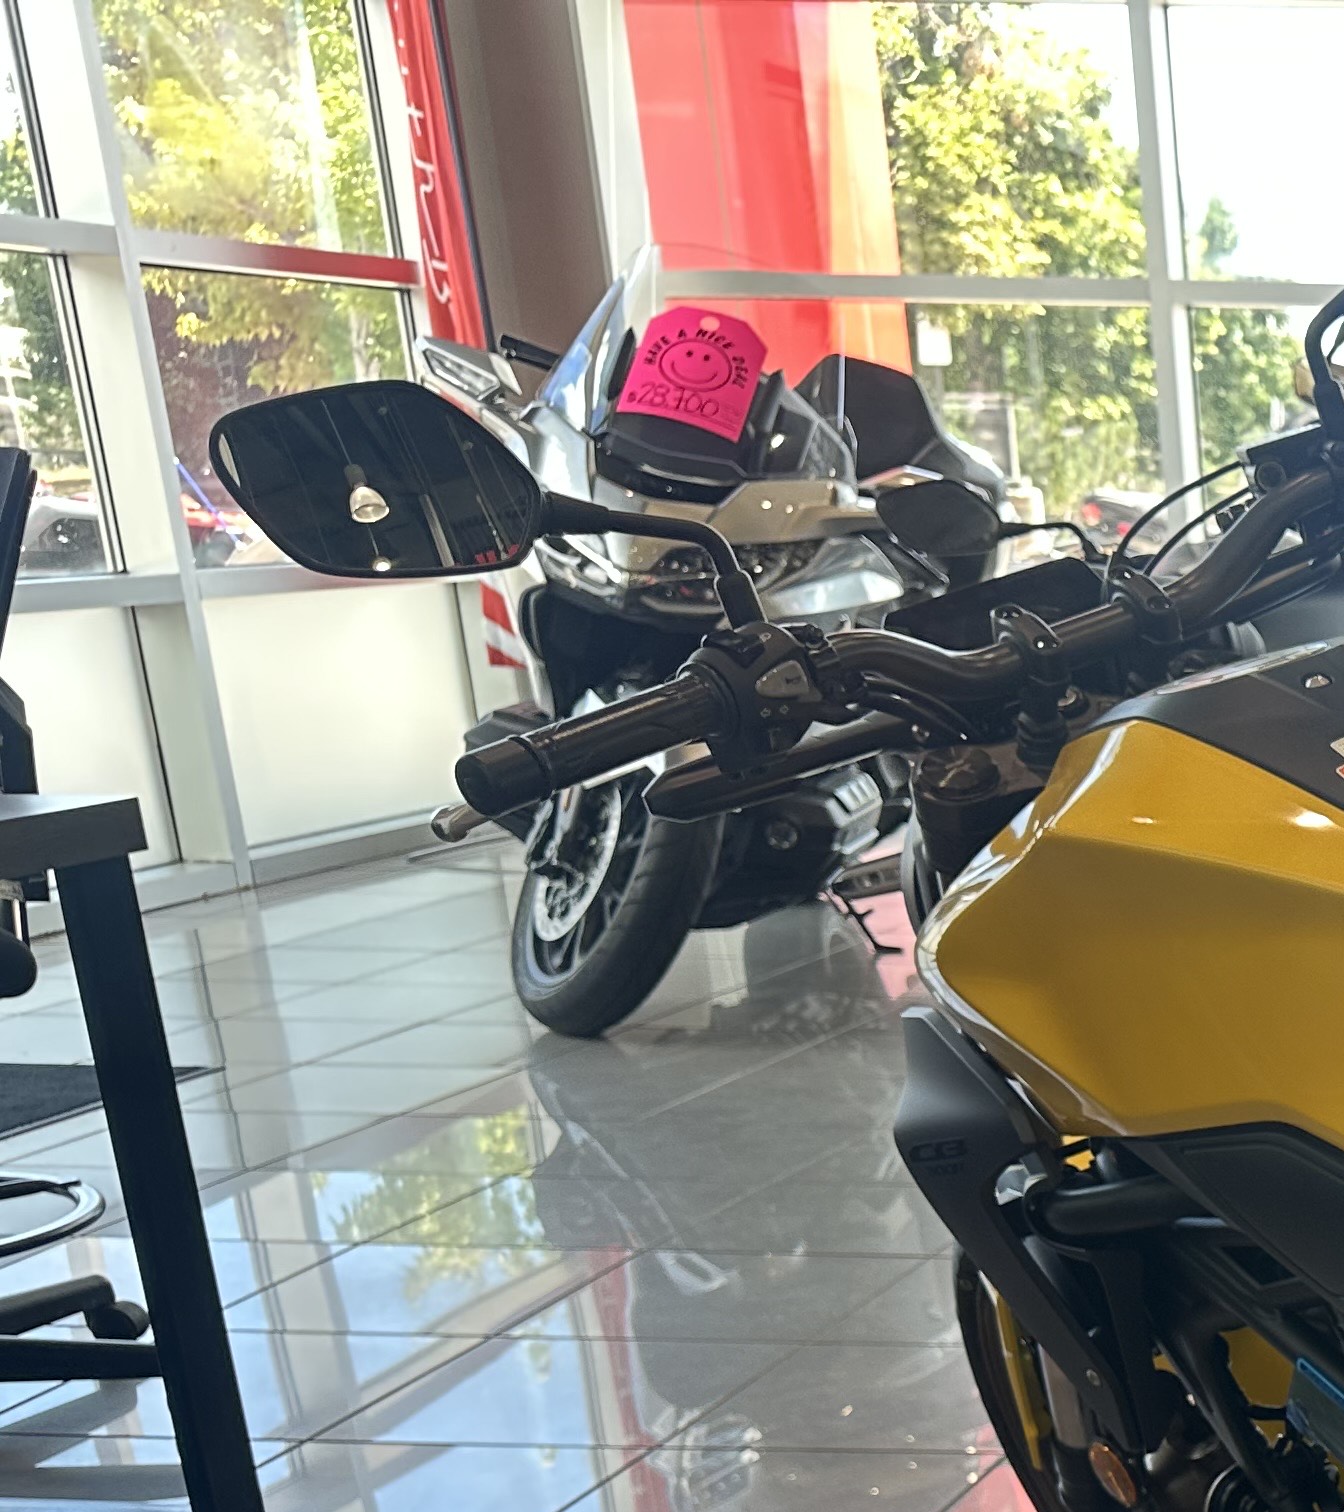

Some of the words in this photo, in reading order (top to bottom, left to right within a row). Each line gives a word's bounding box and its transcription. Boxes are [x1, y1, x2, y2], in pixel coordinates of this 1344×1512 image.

[644, 335, 671, 366] HAVE
[678, 329, 687, 338] A
[696, 328, 735, 350] NICE
